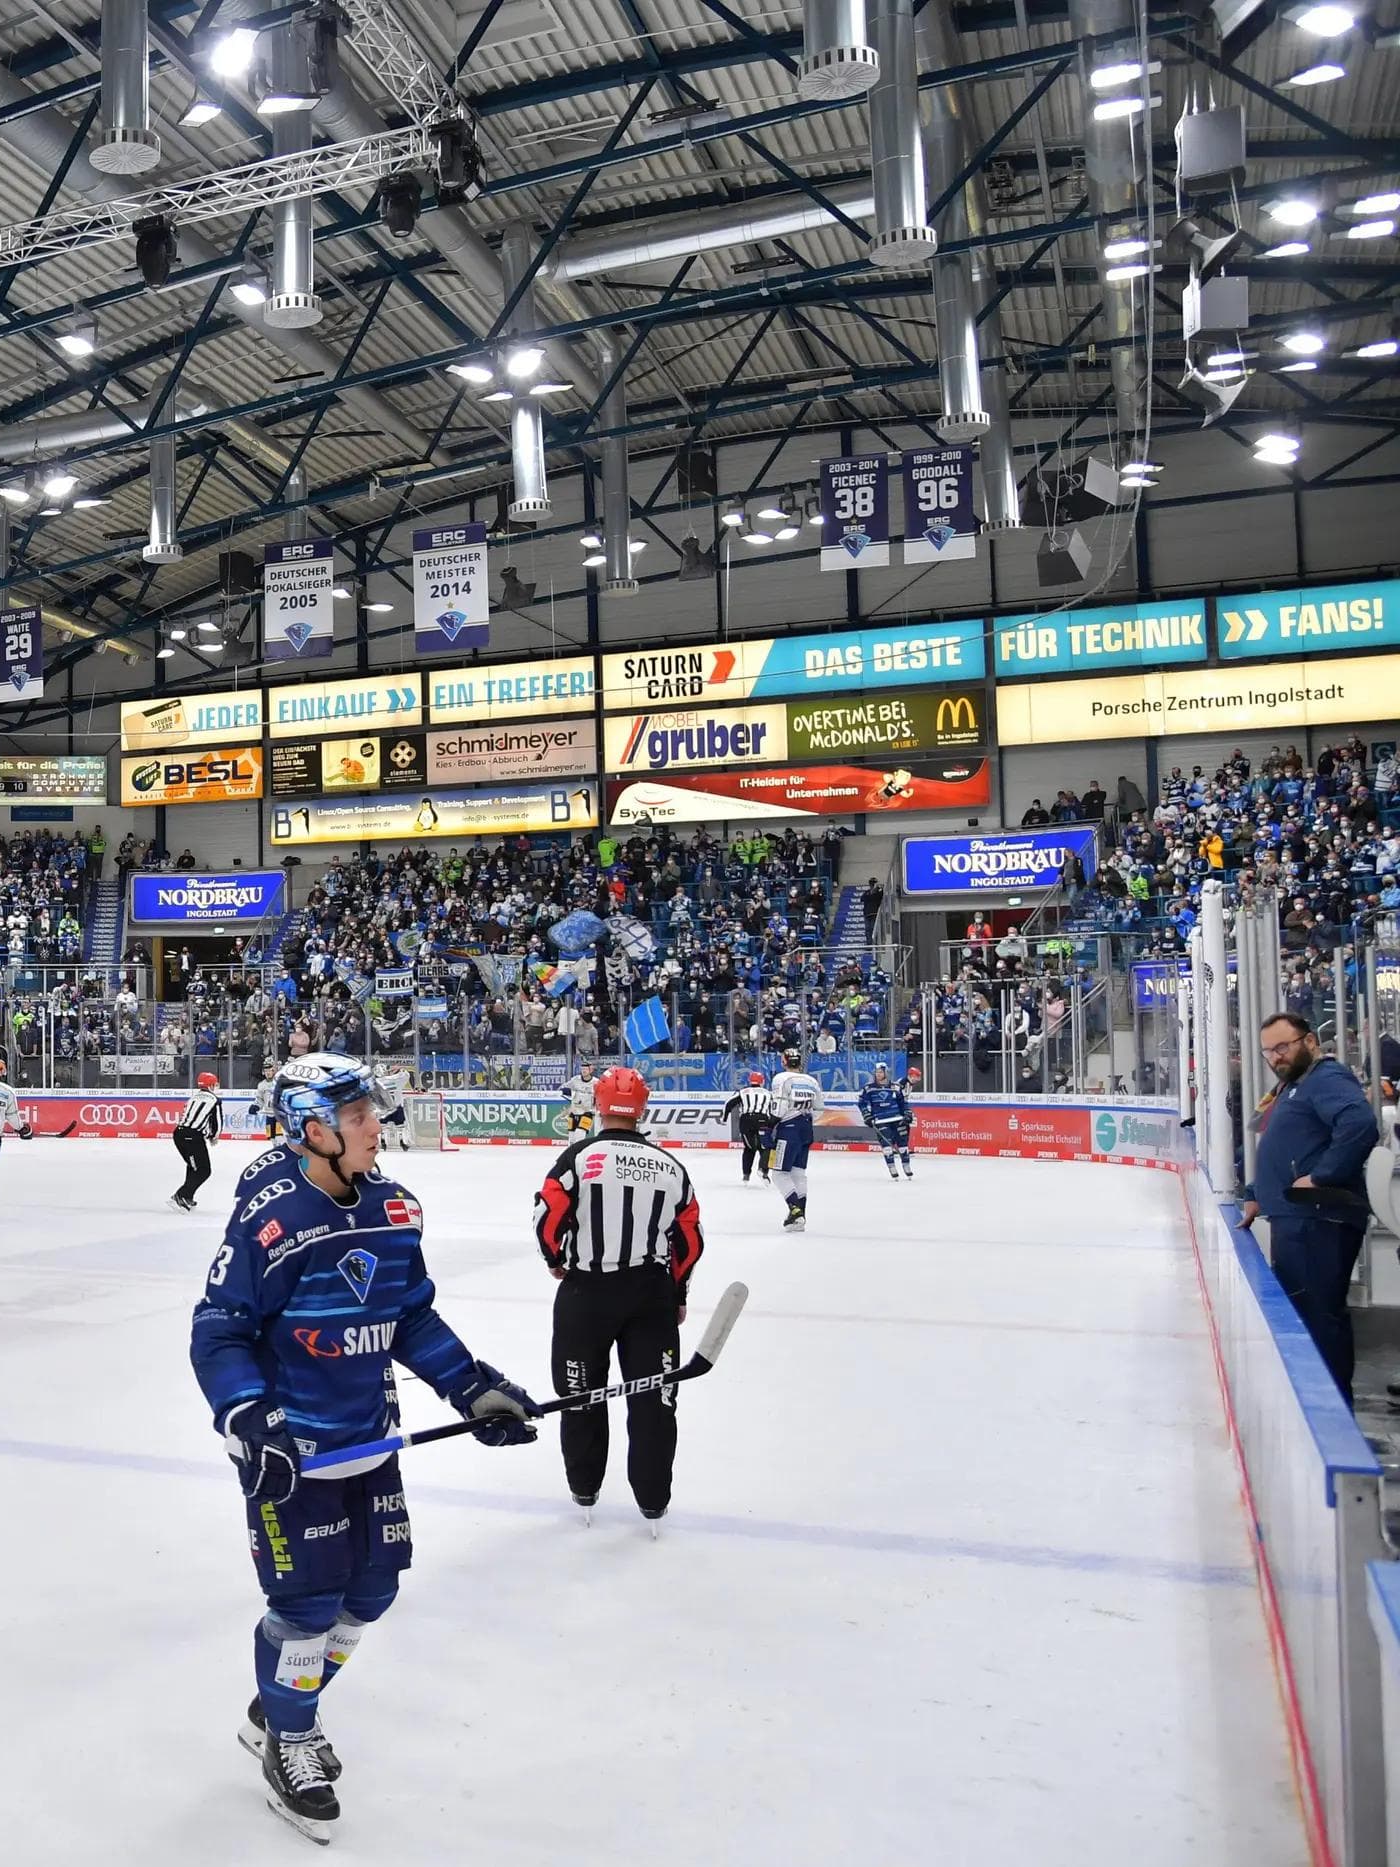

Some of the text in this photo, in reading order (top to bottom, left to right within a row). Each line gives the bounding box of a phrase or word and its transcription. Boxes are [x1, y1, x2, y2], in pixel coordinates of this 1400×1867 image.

[912, 463, 964, 480] GOODALL
[831, 473, 877, 489] FICENEC
[835, 486, 875, 519] 38
[918, 477, 959, 512] 96
[431, 529, 466, 544] ERC
[282, 544, 314, 557] ERC
[419, 552, 481, 569] DEUTSCHER
[270, 566, 328, 581] DEUTSCHER
[425, 566, 476, 581] MEISTER
[265, 578, 332, 594] POKALSIEGER
[430, 581, 472, 599] 2014
[279, 594, 318, 610] 2005
[1279, 598, 1383, 638] FANS!
[7, 622, 30, 635] WAITE
[1000, 614, 1204, 661] FÜR TECHNIK
[5, 632, 32, 661] 29
[805, 636, 962, 678] DAS BESTE
[624, 652, 703, 680] SATURN
[434, 670, 594, 710] EIN TREFFER!
[647, 674, 703, 700] CARD
[278, 690, 379, 722] EINKAUF
[1092, 684, 1345, 717] Porsche Zentrum Ingolstadt
[192, 703, 258, 731] JEDER
[650, 712, 703, 729] MÖBEL
[436, 731, 578, 756] schmidmeyer
[647, 719, 766, 769] gruber
[16, 761, 36, 770] für
[436, 755, 529, 769] Kies Erdbau Abbruch
[164, 760, 253, 785] BESL
[739, 775, 806, 788] IT-Helden für
[786, 785, 858, 800] Unternehmen
[620, 805, 675, 820] SysTec
[933, 848, 1066, 876] NORDBRÄU
[970, 874, 1035, 887] INGOLSTADT
[158, 887, 263, 909] NORDBRÄU
[186, 909, 238, 918] INGOLSTADT
[145, 1107, 183, 1125] Au
[921, 1119, 959, 1129] Sparkasse
[1020, 1122, 1054, 1132] Sparkasse
[921, 1131, 993, 1141] Ingolstadt Eichstätt
[1021, 1134, 1055, 1143] Ingolstadt
[615, 1154, 677, 1177] MAGENTA
[616, 1168, 659, 1184] SPORT
[260, 1222, 282, 1245] DB
[267, 1224, 331, 1261] Regio Bayern
